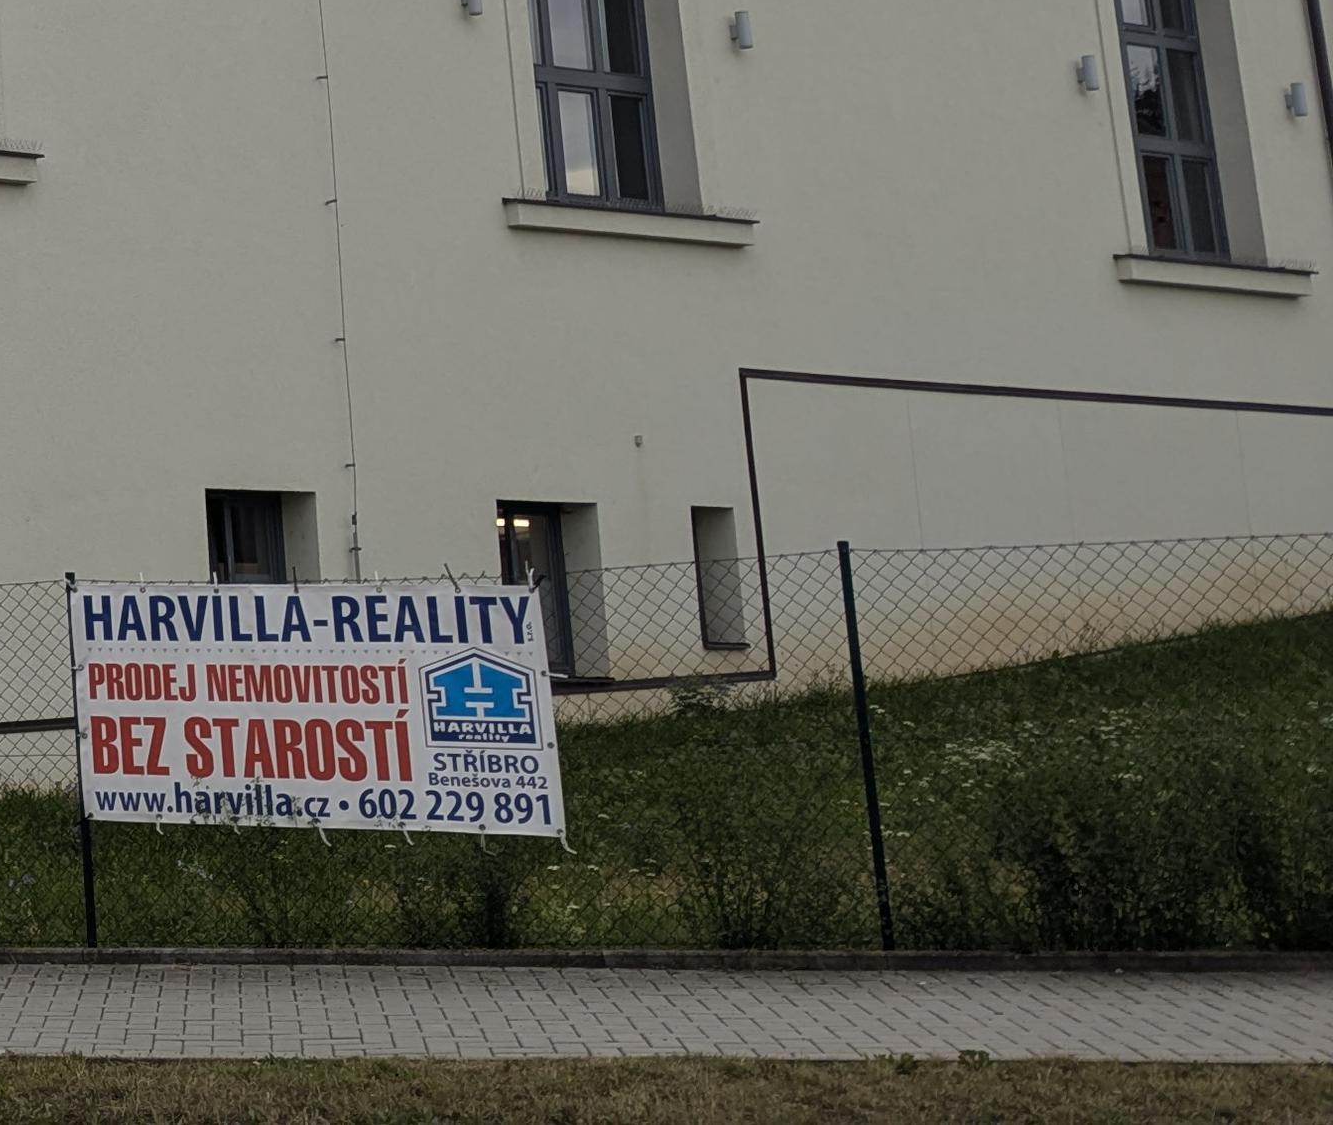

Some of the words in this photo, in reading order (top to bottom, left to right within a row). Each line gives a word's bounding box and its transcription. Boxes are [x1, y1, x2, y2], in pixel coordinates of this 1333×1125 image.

[83, 594, 530, 645] HARVILLA-REALITY
[88, 662, 196, 702] PRODEJ
[206, 658, 409, 705] NEMOVITOSTÍ
[433, 721, 533, 735] HARVILLA
[458, 733, 510, 743] reality
[90, 715, 170, 776] BEZ
[184, 709, 414, 782] STAROSTÍ
[433, 749, 539, 775] STŘÍBRO
[428, 773, 511, 789] Benešova
[516, 776, 548, 790] 442
[95, 782, 331, 820] www.harvilla.cz
[358, 788, 415, 819] 602
[424, 789, 484, 822] 229
[494, 791, 552, 825] 891
